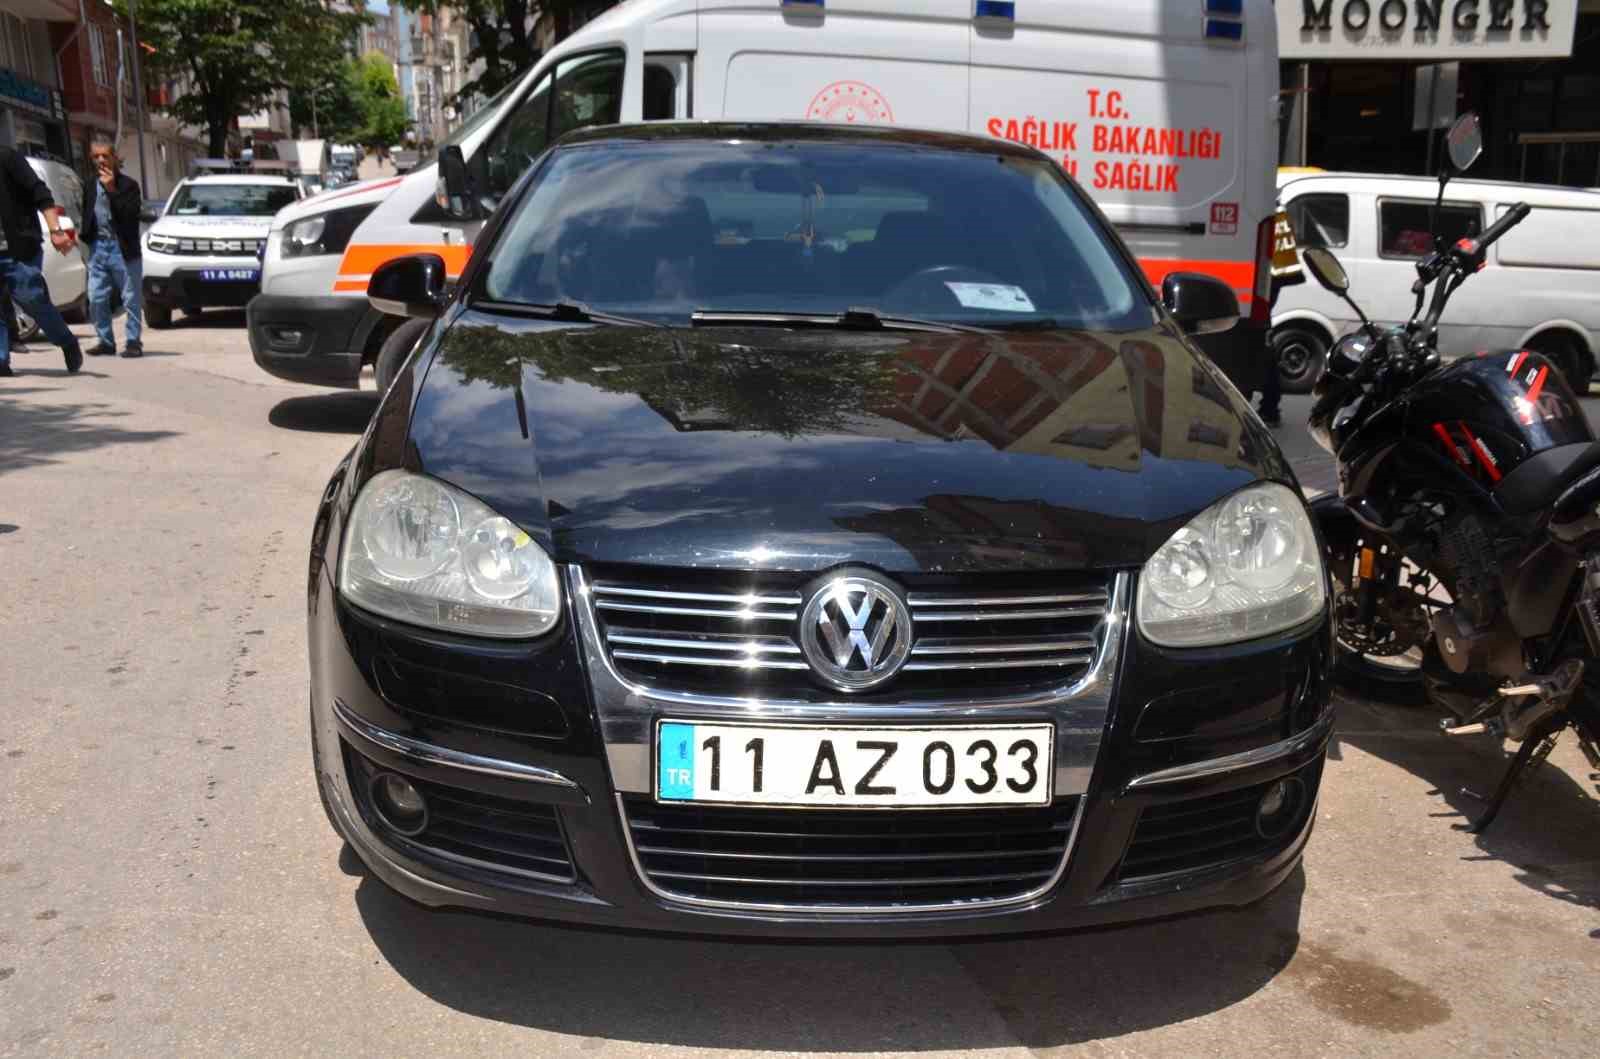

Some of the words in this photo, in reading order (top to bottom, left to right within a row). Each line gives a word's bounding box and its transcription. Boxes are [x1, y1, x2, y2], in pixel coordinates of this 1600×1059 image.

[1299, 0, 1551, 31] MOONGER
[1087, 89, 1129, 119] T.C.
[987, 115, 1078, 151] SAĞLIK
[1093, 123, 1224, 160] BAKANLIĞI
[1093, 158, 1181, 192] SAĞLIK
[1213, 206, 1235, 223] 112
[667, 768, 691, 785] TR
[703, 735, 765, 793] 11
[804, 739, 899, 796] AZ
[922, 738, 1039, 795] 033
